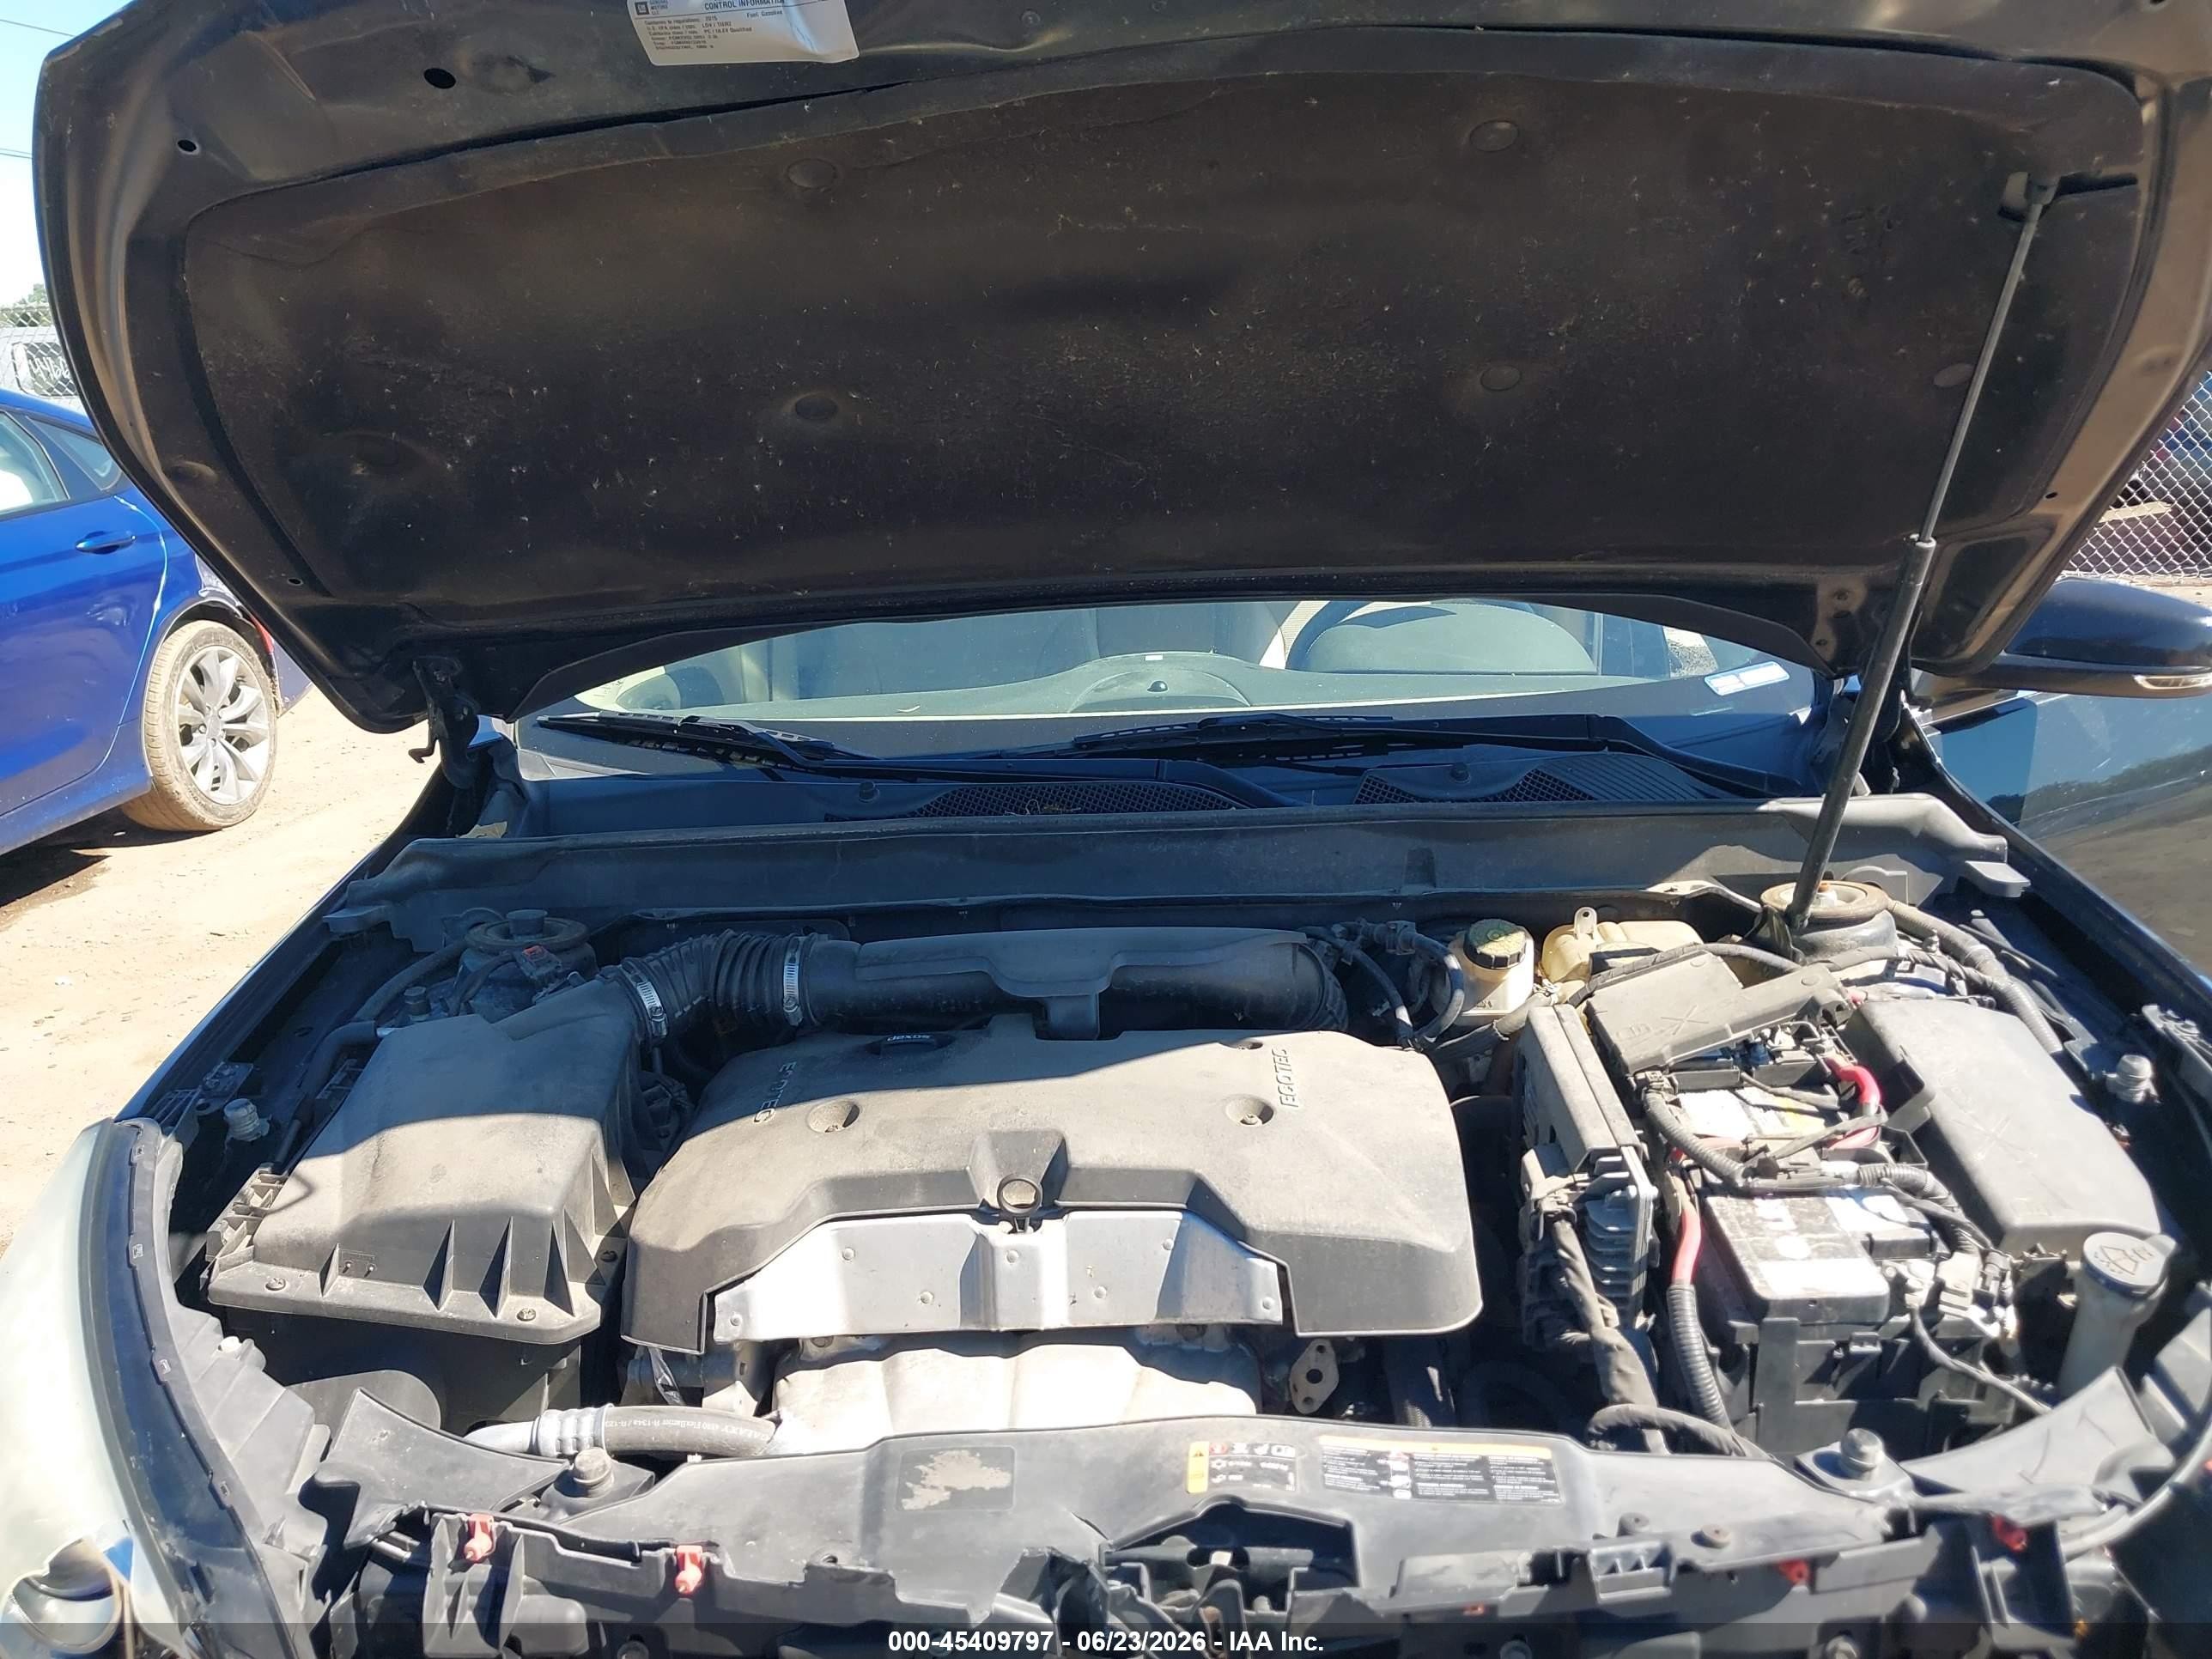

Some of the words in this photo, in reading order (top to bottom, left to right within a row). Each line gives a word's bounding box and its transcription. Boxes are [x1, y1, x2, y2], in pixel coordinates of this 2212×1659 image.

[704, 0, 737, 10] CONTROL
[753, 1060, 798, 1123] ECOTEC
[1271, 1047, 1300, 1109] ECOTEC
